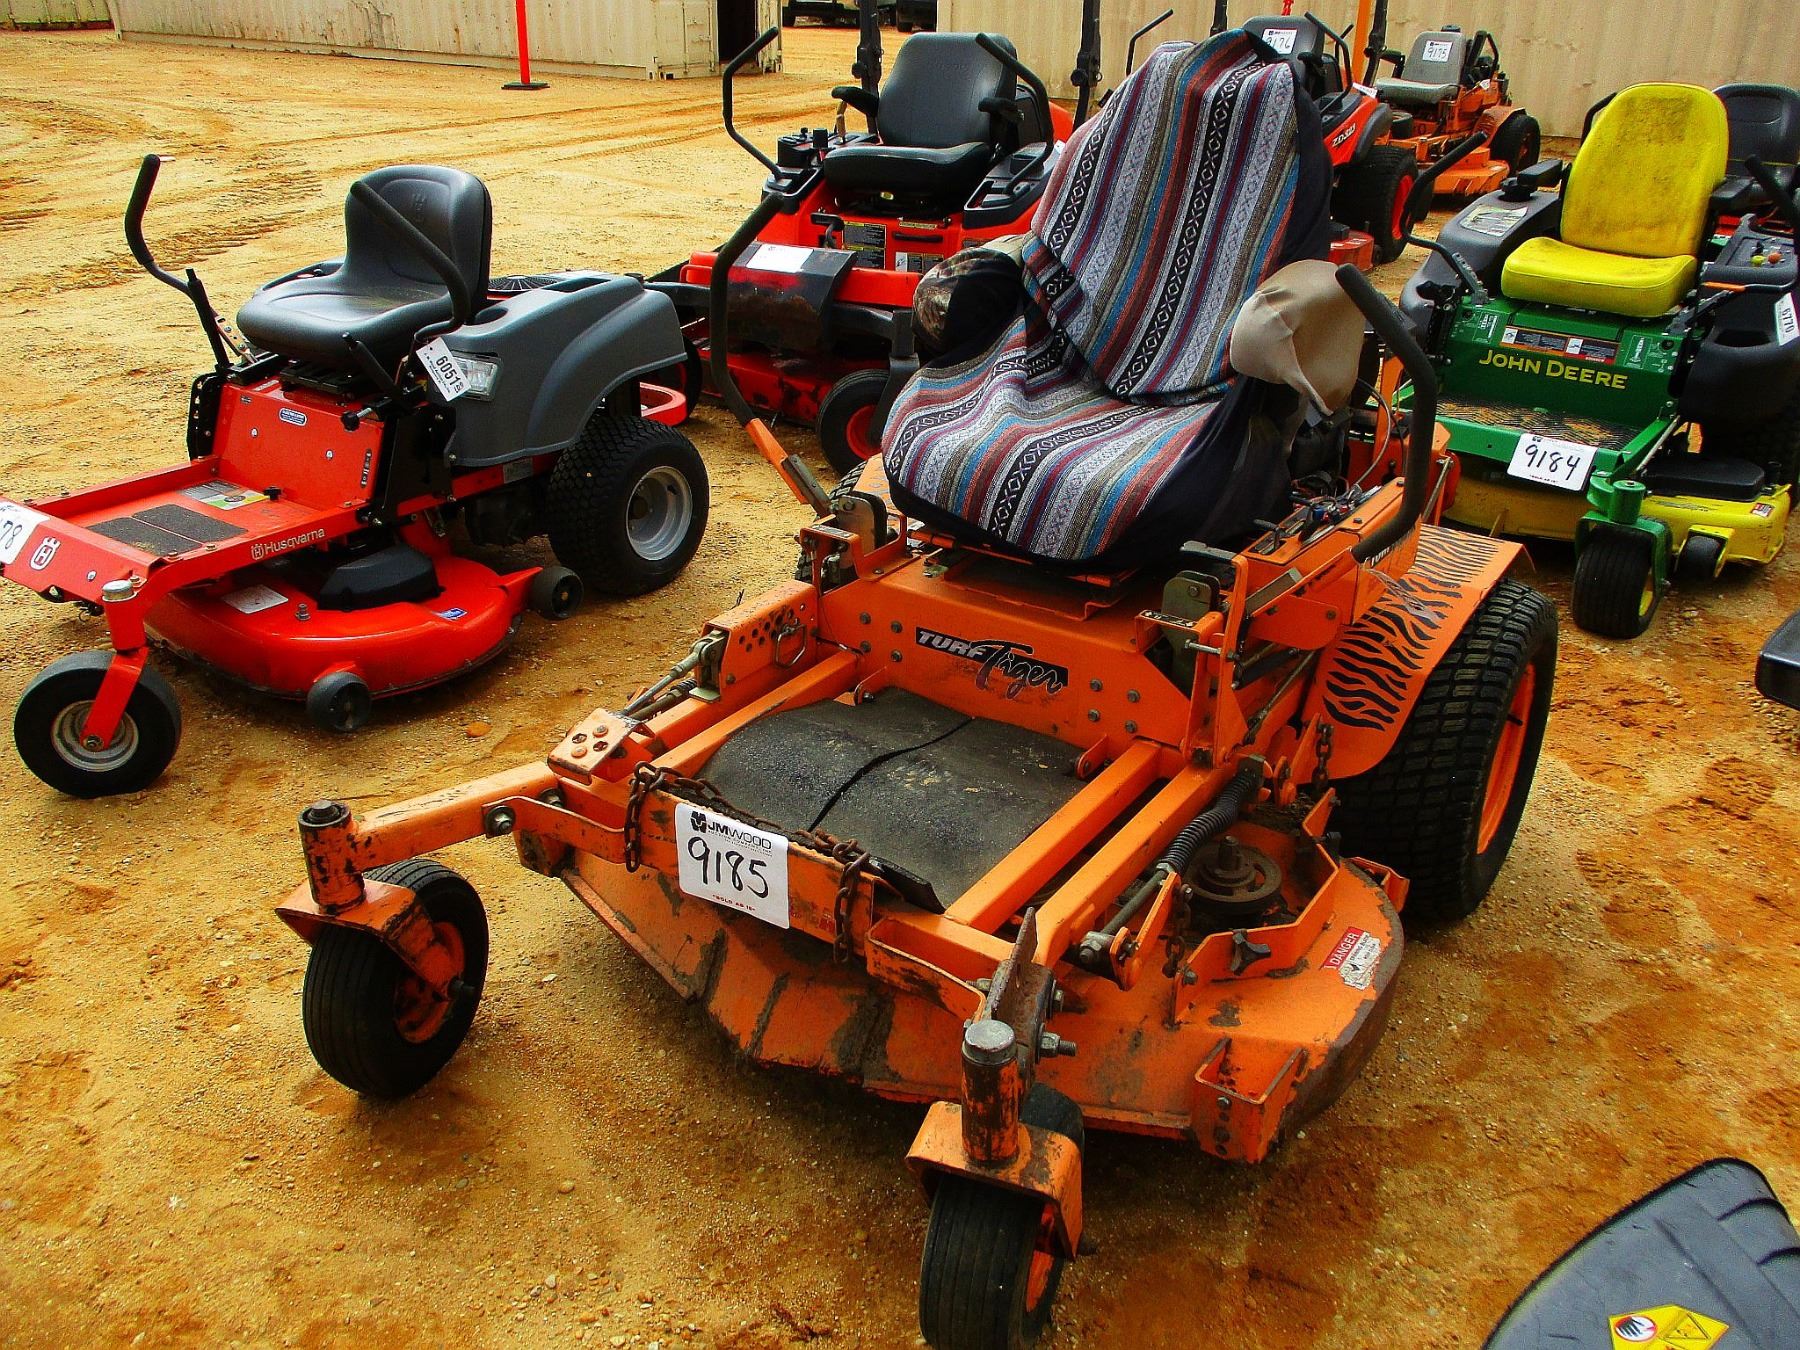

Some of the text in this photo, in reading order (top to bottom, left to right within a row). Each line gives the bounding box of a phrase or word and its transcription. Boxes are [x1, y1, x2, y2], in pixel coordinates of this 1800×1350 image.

[1428, 47, 1448, 59] 9175
[435, 355, 462, 386] 6051
[1479, 349, 1629, 390] JOHN DEERE
[1525, 443, 1582, 481] 9184
[265, 528, 326, 555] Husqvarna
[917, 630, 1065, 700] TURF Tiger
[687, 836, 769, 899] 9185
[1329, 932, 1360, 966] DANGER
